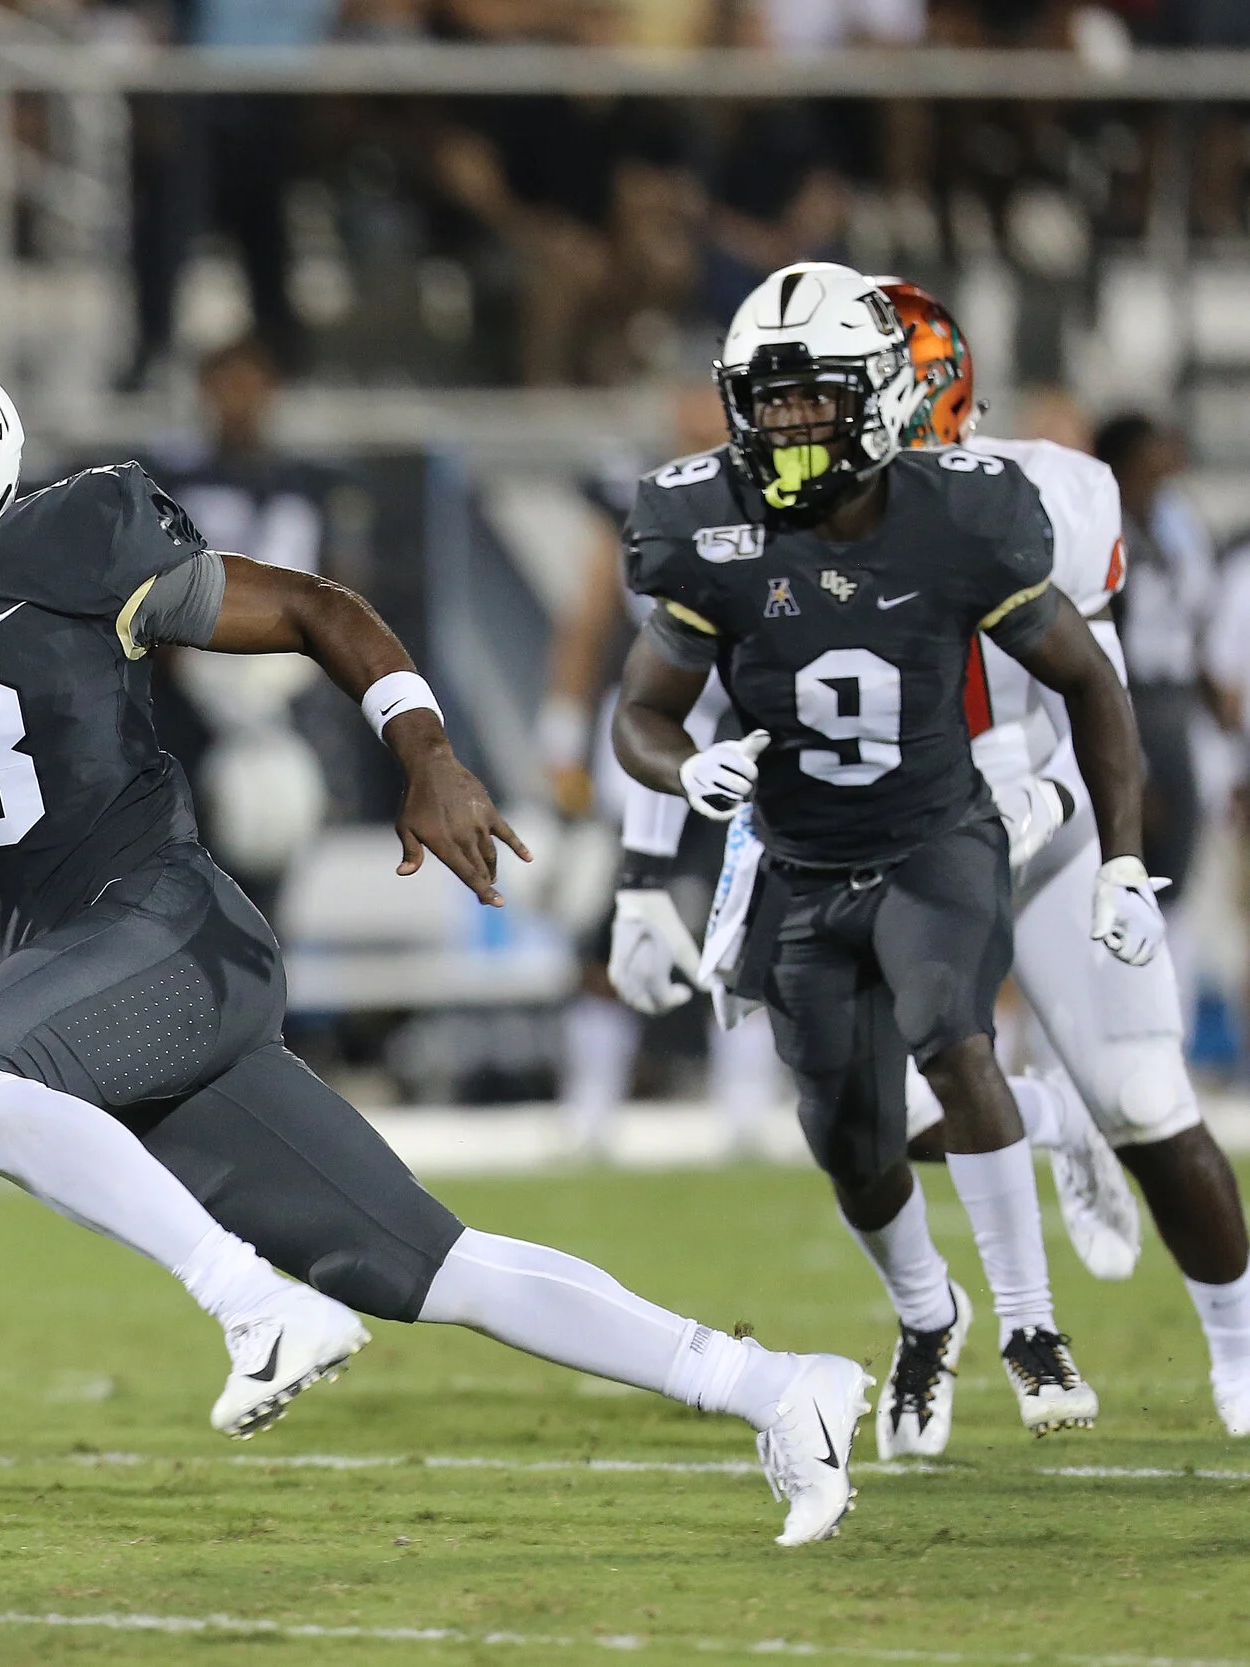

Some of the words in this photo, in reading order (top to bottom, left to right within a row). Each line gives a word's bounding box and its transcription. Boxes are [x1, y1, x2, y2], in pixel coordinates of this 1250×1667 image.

[656, 456, 721, 489] 9
[938, 450, 1005, 476] 9
[819, 570, 858, 602] UCF
[795, 648, 902, 786] 9
